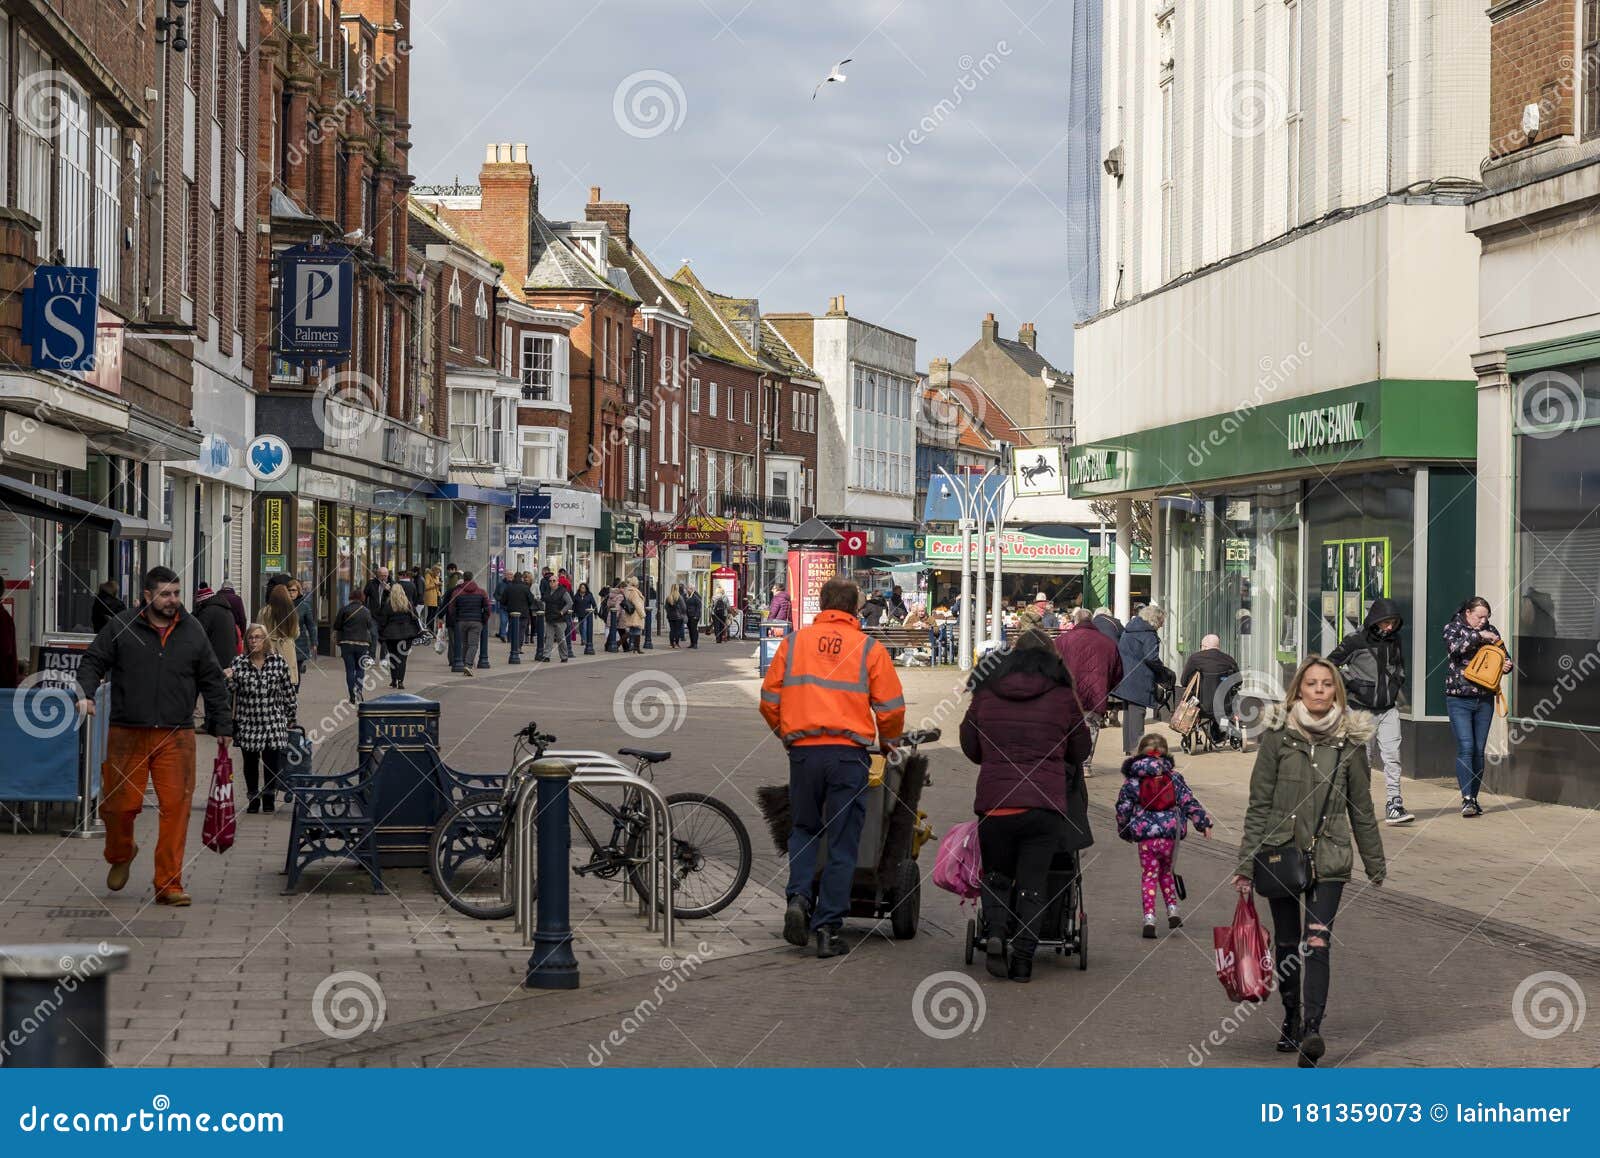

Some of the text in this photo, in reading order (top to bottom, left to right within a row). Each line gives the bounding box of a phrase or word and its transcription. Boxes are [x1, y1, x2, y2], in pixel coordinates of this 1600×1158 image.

[46, 274, 88, 295] WH
[304, 269, 333, 321] P
[41, 295, 85, 364] S
[295, 327, 339, 341] Palmers
[1288, 401, 1358, 450] LLOYDS BANK
[1070, 455, 1091, 485] LLOYDS
[271, 500, 279, 521] STORE
[560, 502, 580, 510] YOURS
[662, 531, 711, 540] THE ROWS
[1013, 543, 1082, 558] Vegetables
[808, 569, 836, 577] BINGO
[818, 635, 843, 655] GYB
[375, 724, 425, 738] LITTER
